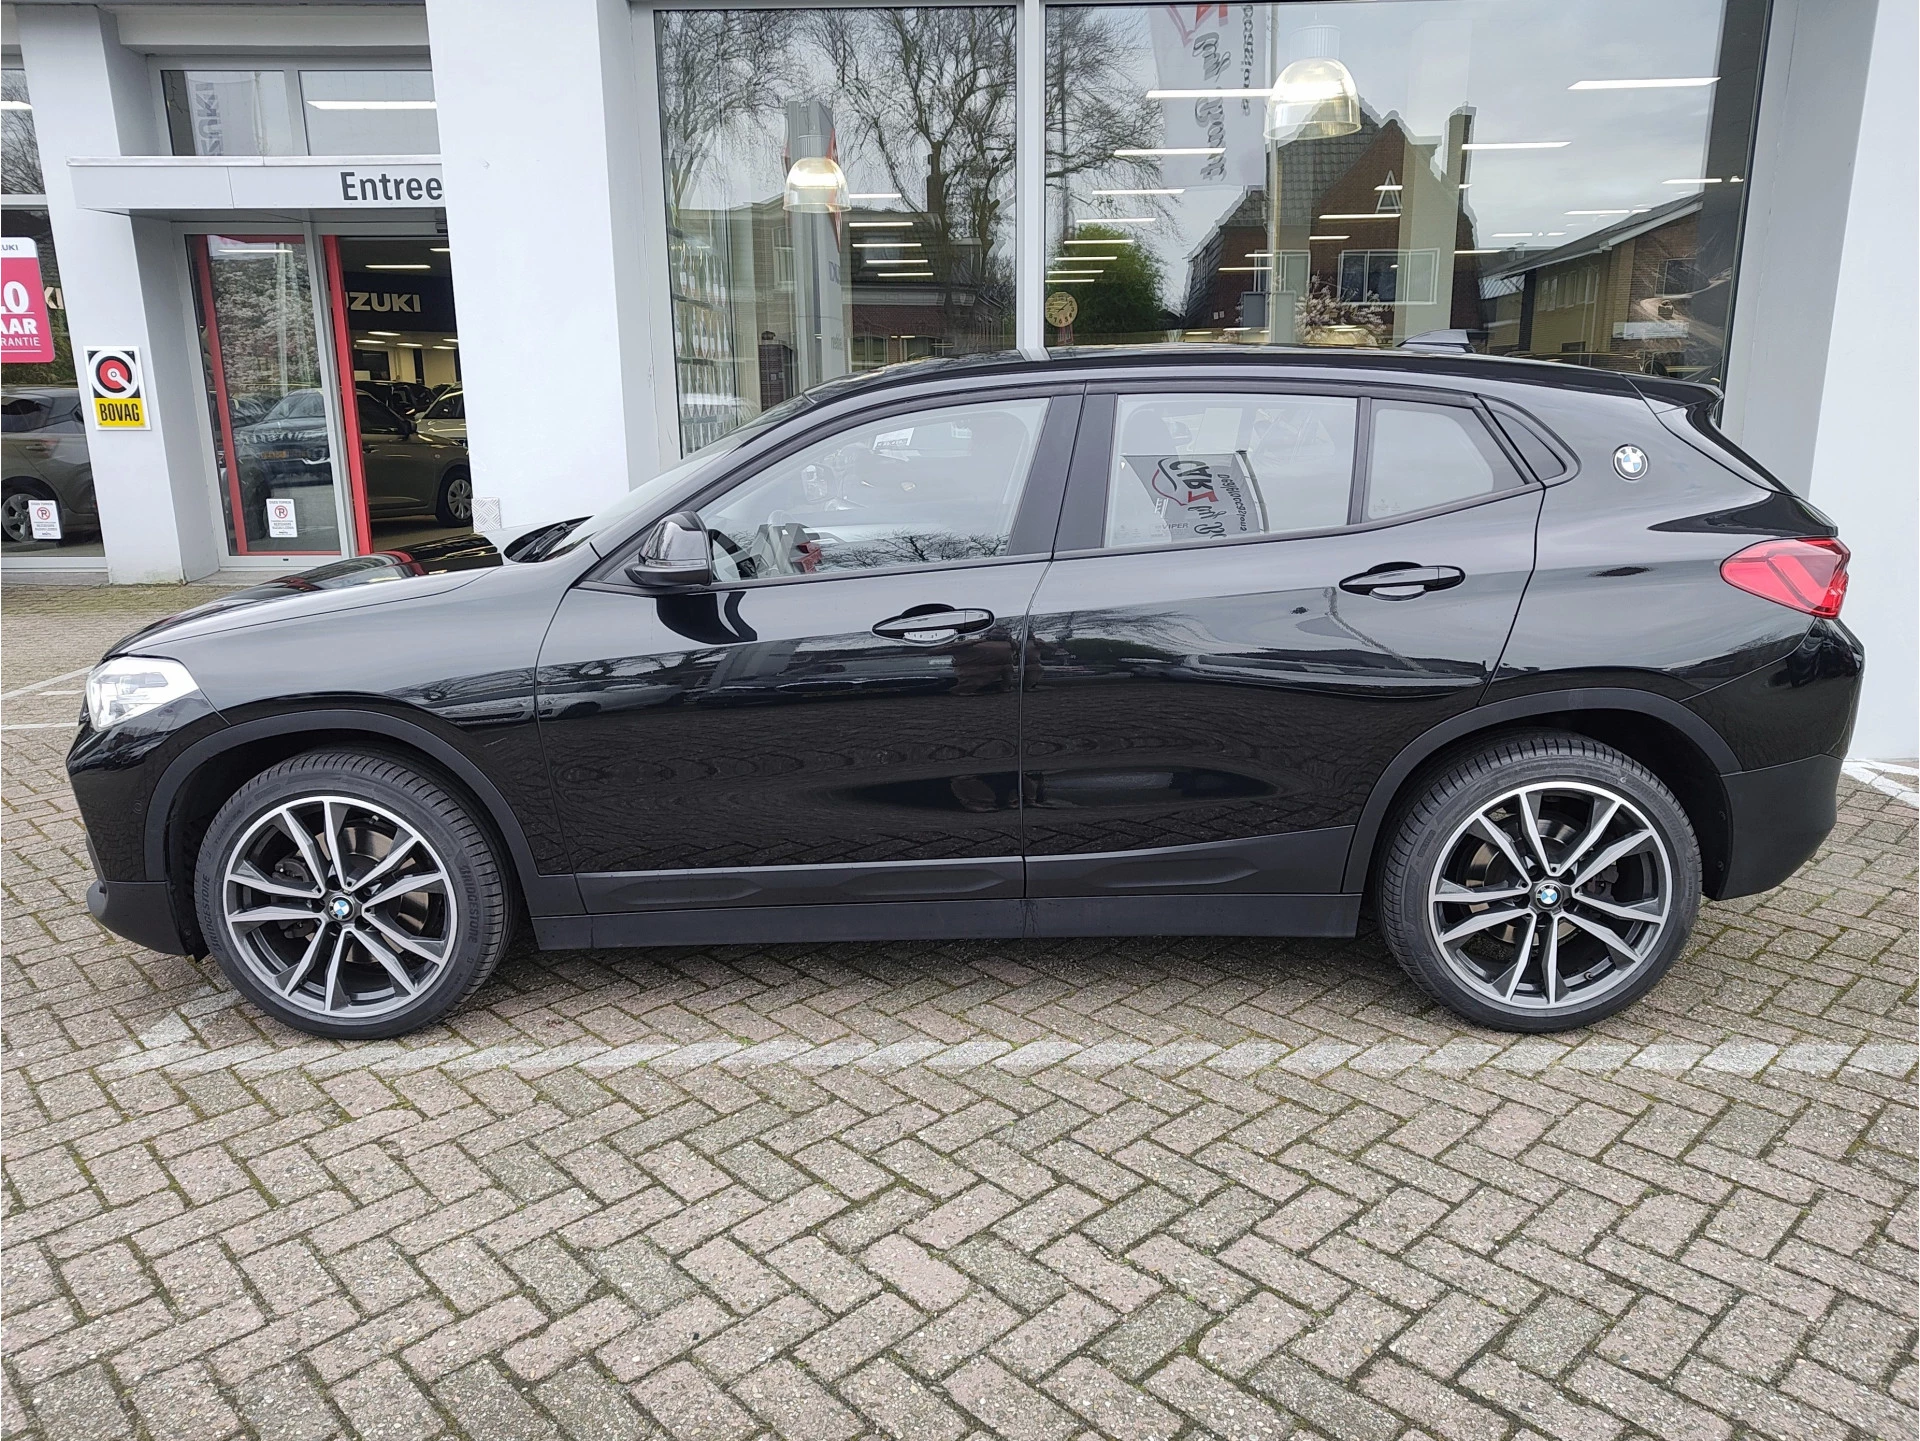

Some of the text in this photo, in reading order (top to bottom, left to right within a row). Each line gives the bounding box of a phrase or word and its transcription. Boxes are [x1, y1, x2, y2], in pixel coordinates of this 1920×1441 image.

[340, 171, 442, 201] Entree
[344, 292, 421, 312] ZUKI
[99, 403, 140, 422] BOVAG
